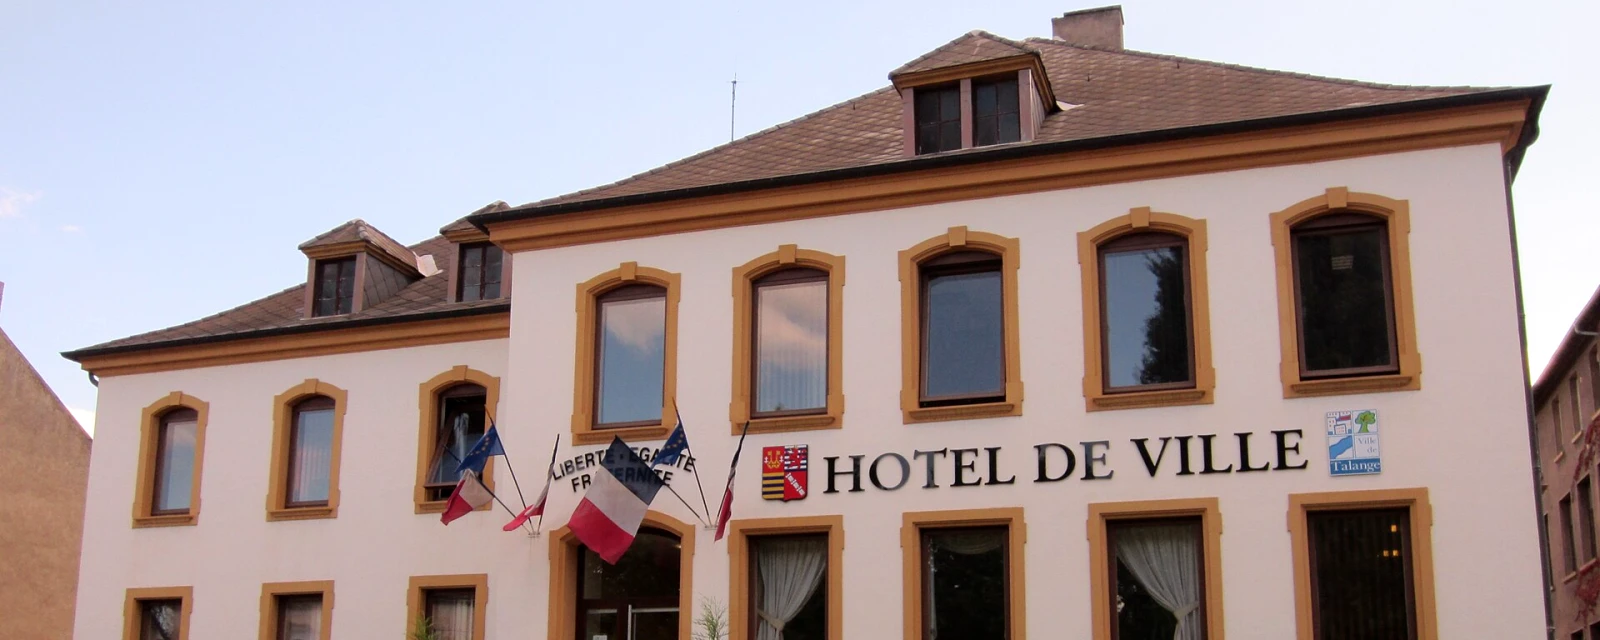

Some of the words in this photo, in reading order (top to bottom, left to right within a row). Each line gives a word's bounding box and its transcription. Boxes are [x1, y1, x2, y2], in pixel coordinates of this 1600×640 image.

[823, 447, 1016, 494] HOTEL
[1033, 440, 1114, 483] DE
[1130, 429, 1308, 477] VILLE
[1331, 460, 1380, 472] Talange
